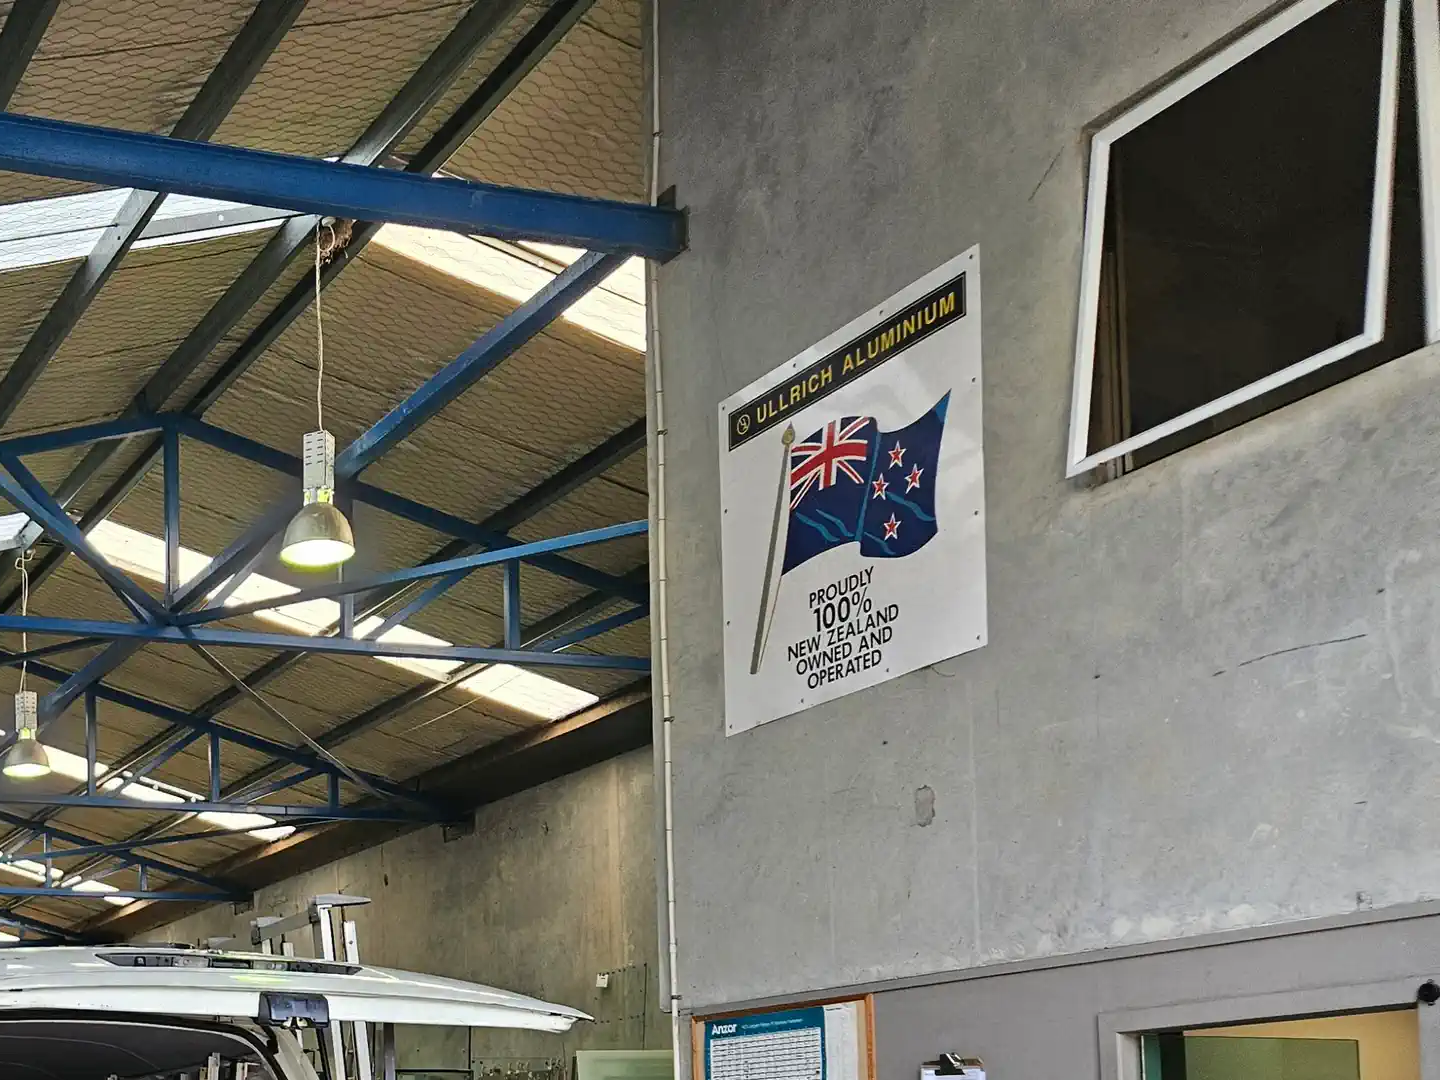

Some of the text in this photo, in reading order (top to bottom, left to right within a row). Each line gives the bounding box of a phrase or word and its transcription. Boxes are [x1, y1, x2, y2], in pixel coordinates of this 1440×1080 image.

[756, 291, 956, 424] ULLRICH ALUMINIUM
[809, 566, 874, 608] PROUDLY
[813, 587, 872, 632] 100%
[788, 604, 899, 662] NEW ZEALAND
[796, 626, 893, 675] OWNED AND
[807, 649, 882, 689] OPERATED
[711, 1023, 737, 1036] Anzor
